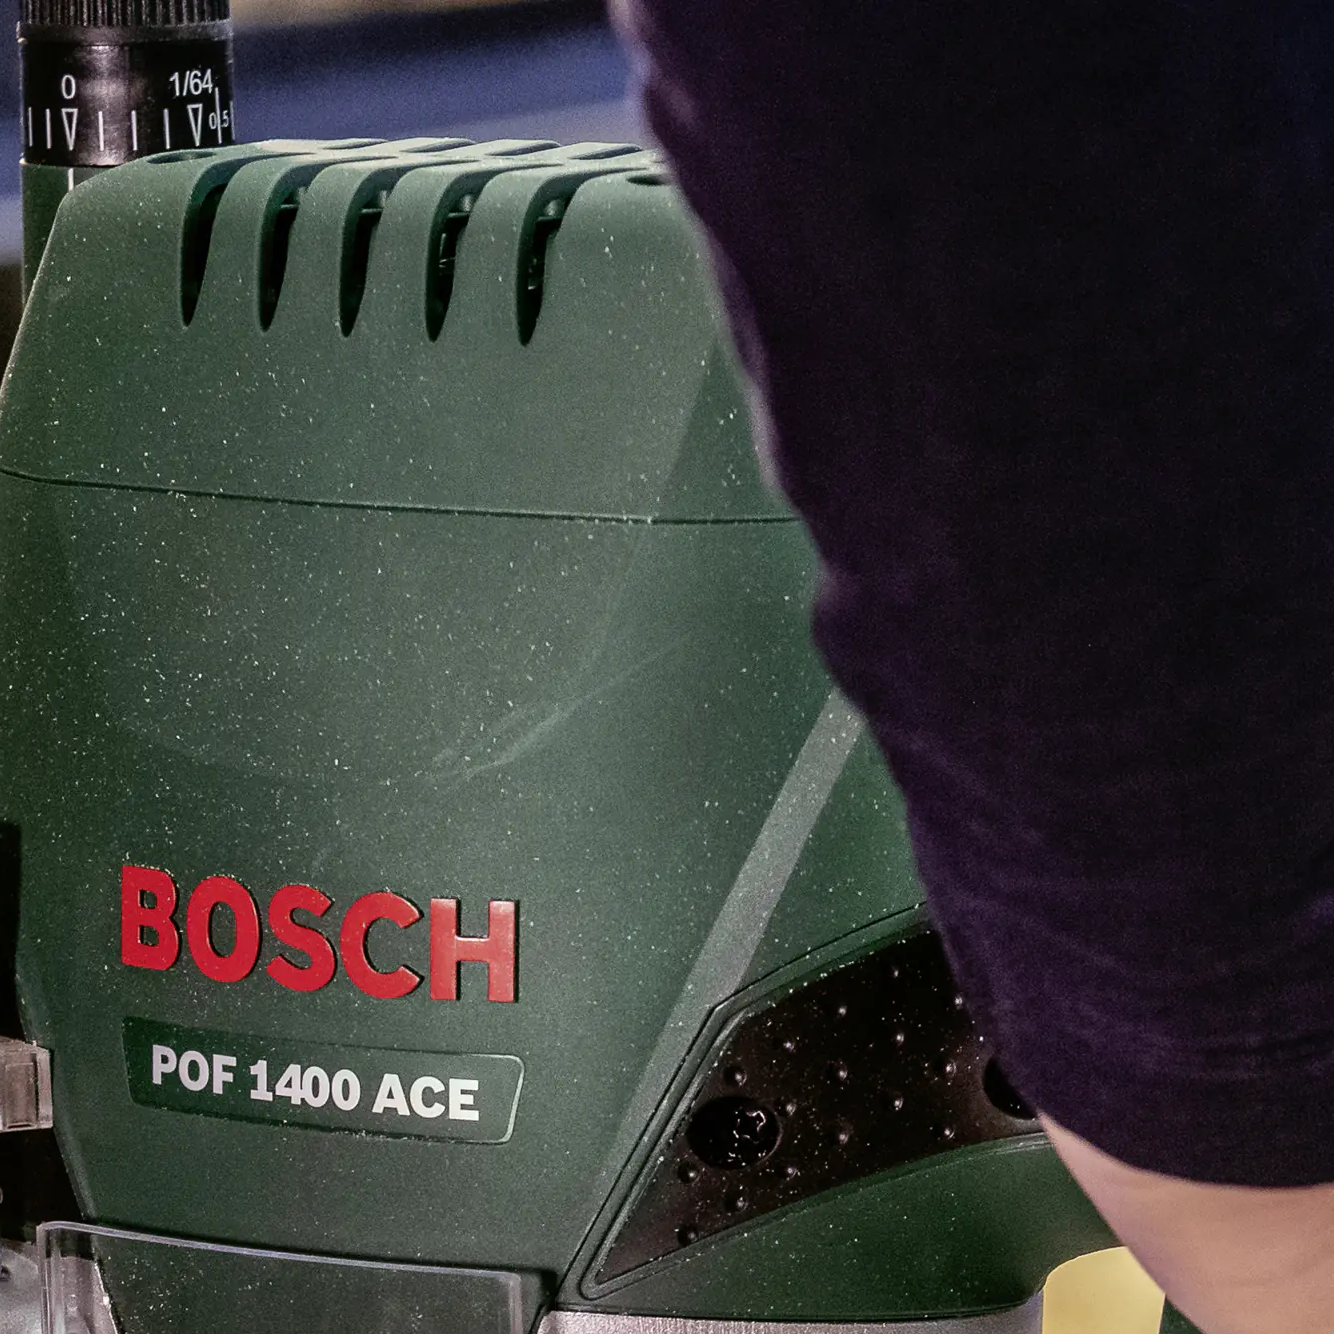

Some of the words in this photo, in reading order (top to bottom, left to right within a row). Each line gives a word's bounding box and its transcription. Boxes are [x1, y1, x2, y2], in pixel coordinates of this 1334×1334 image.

[61, 74, 76, 99] 0
[169, 68, 213, 97] 1/64
[121, 864, 519, 1003] BOSCH
[151, 1044, 237, 1094] POF
[248, 1059, 361, 1111] 1400
[371, 1073, 480, 1121] ACE
